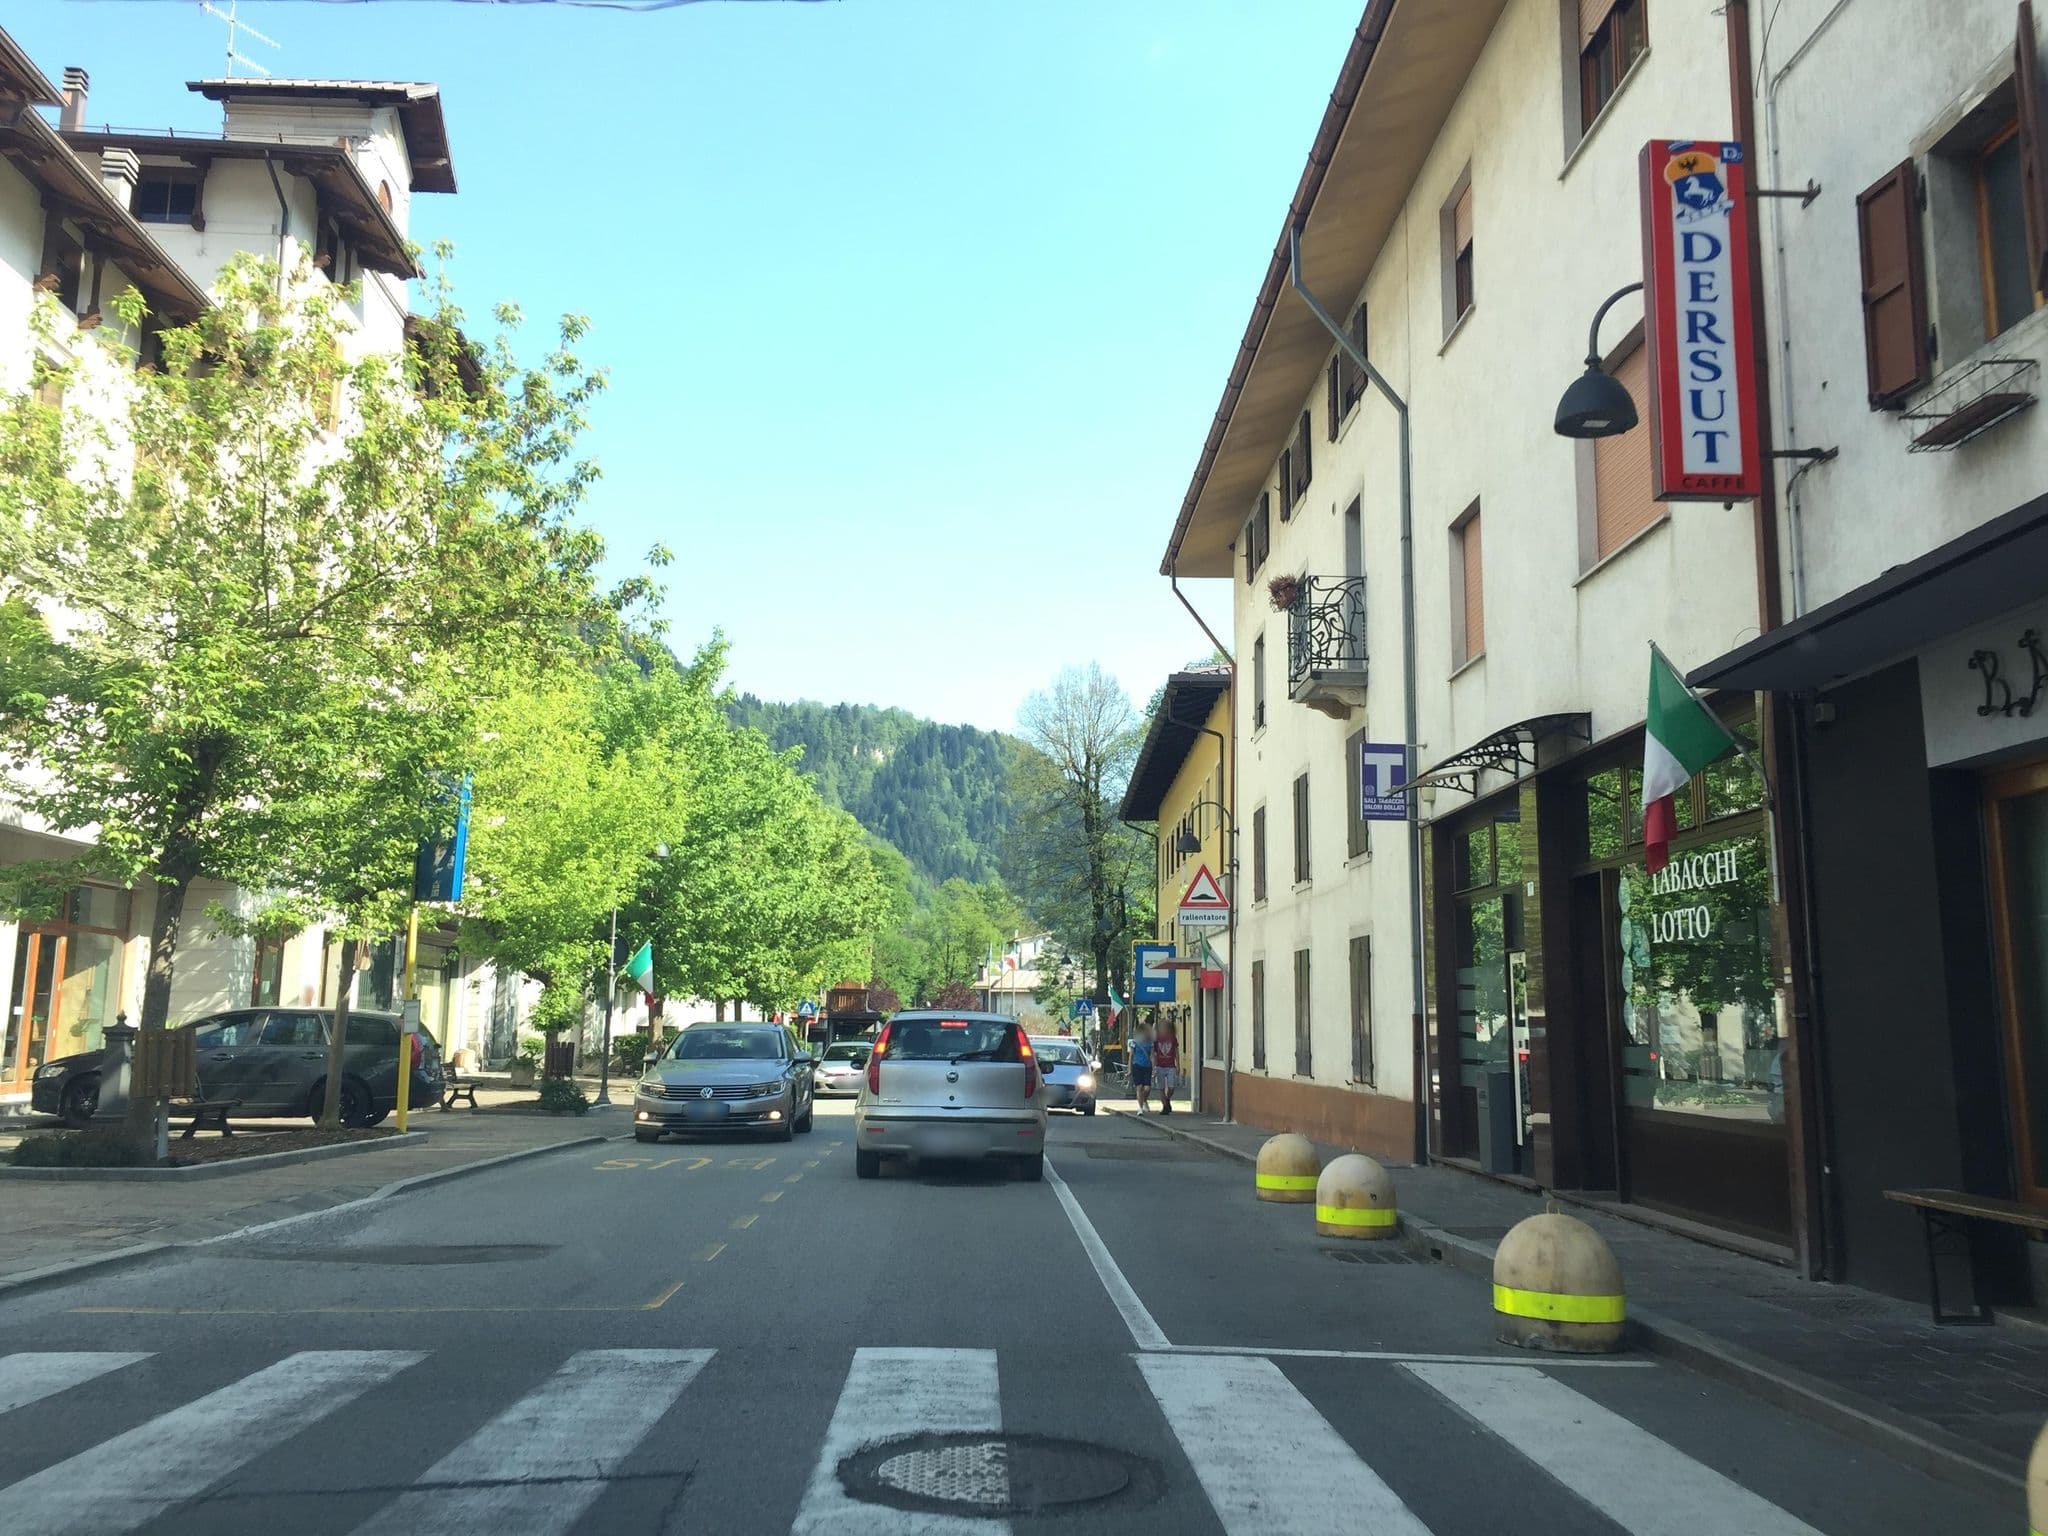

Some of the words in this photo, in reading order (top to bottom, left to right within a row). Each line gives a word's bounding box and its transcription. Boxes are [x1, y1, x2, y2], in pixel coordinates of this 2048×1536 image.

[1680, 231, 1730, 463] DERSUT
[1364, 752, 1404, 797] T
[1182, 913, 1227, 921] rallentatore
[1652, 905, 1711, 944] LOTTO
